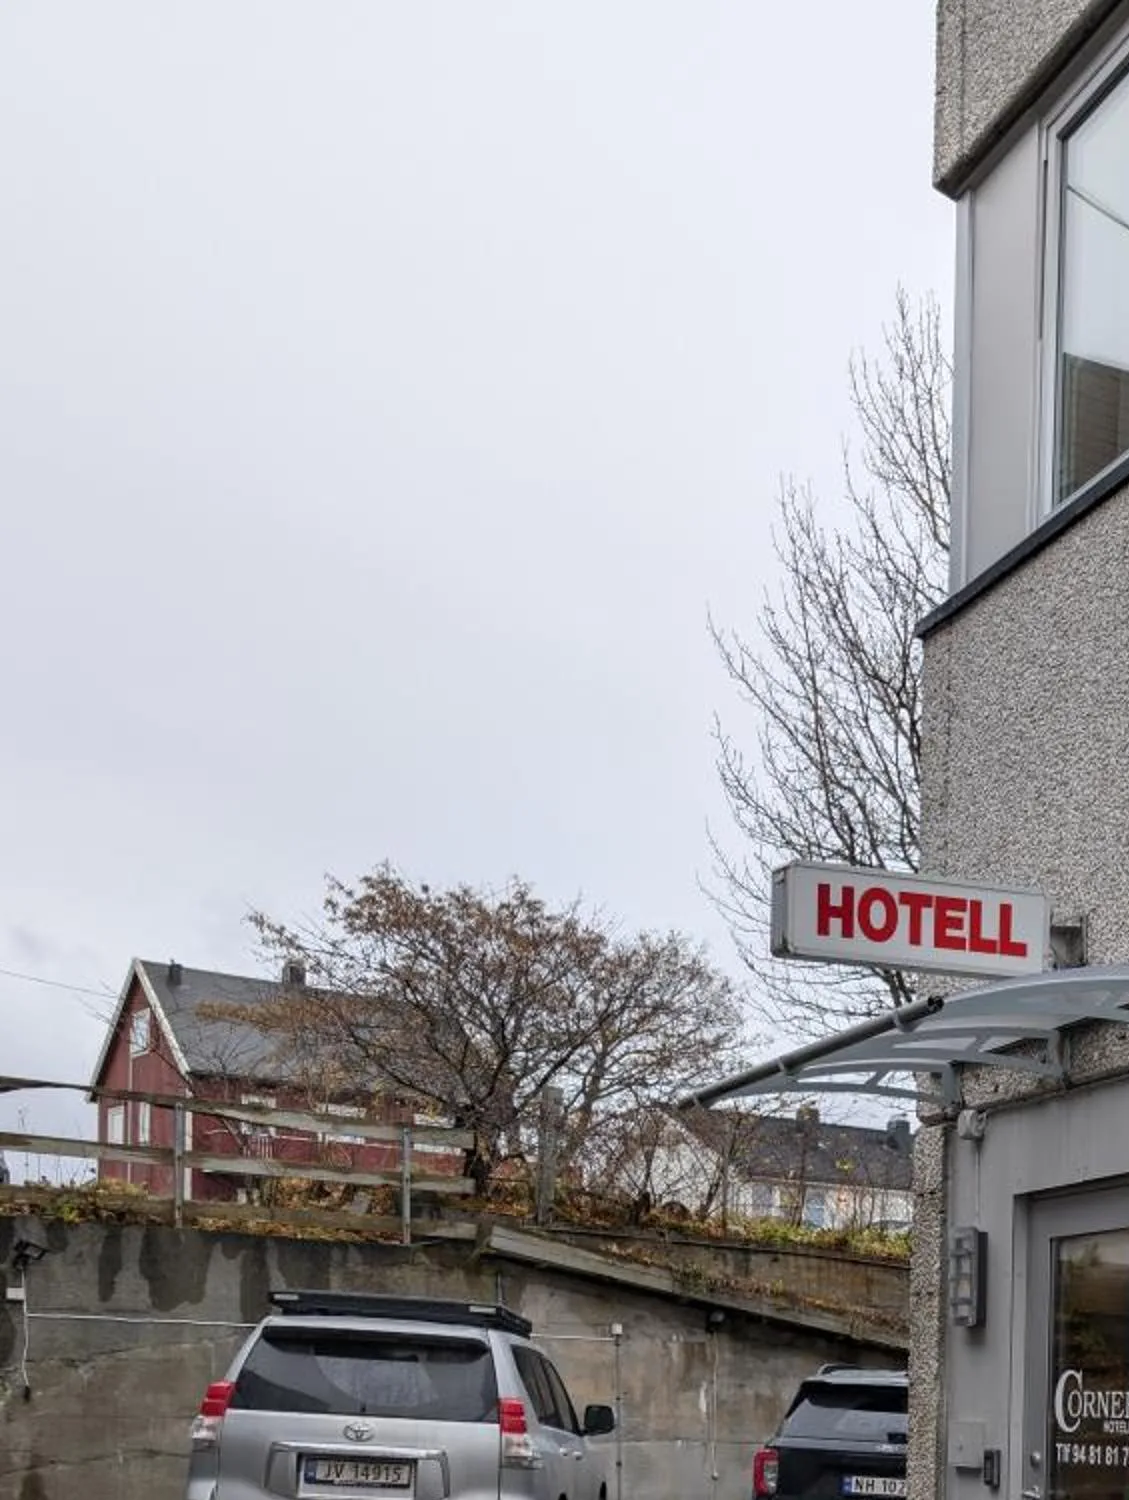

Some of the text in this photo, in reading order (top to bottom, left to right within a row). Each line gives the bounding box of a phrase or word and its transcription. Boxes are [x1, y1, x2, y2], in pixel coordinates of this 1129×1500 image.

[817, 883, 1028, 957] HOTELL
[1072, 1444, 1086, 1463] 94
[1088, 1445, 1101, 1465] 81
[1105, 1446, 1119, 1466] 81
[854, 1478, 875, 1492] NH
